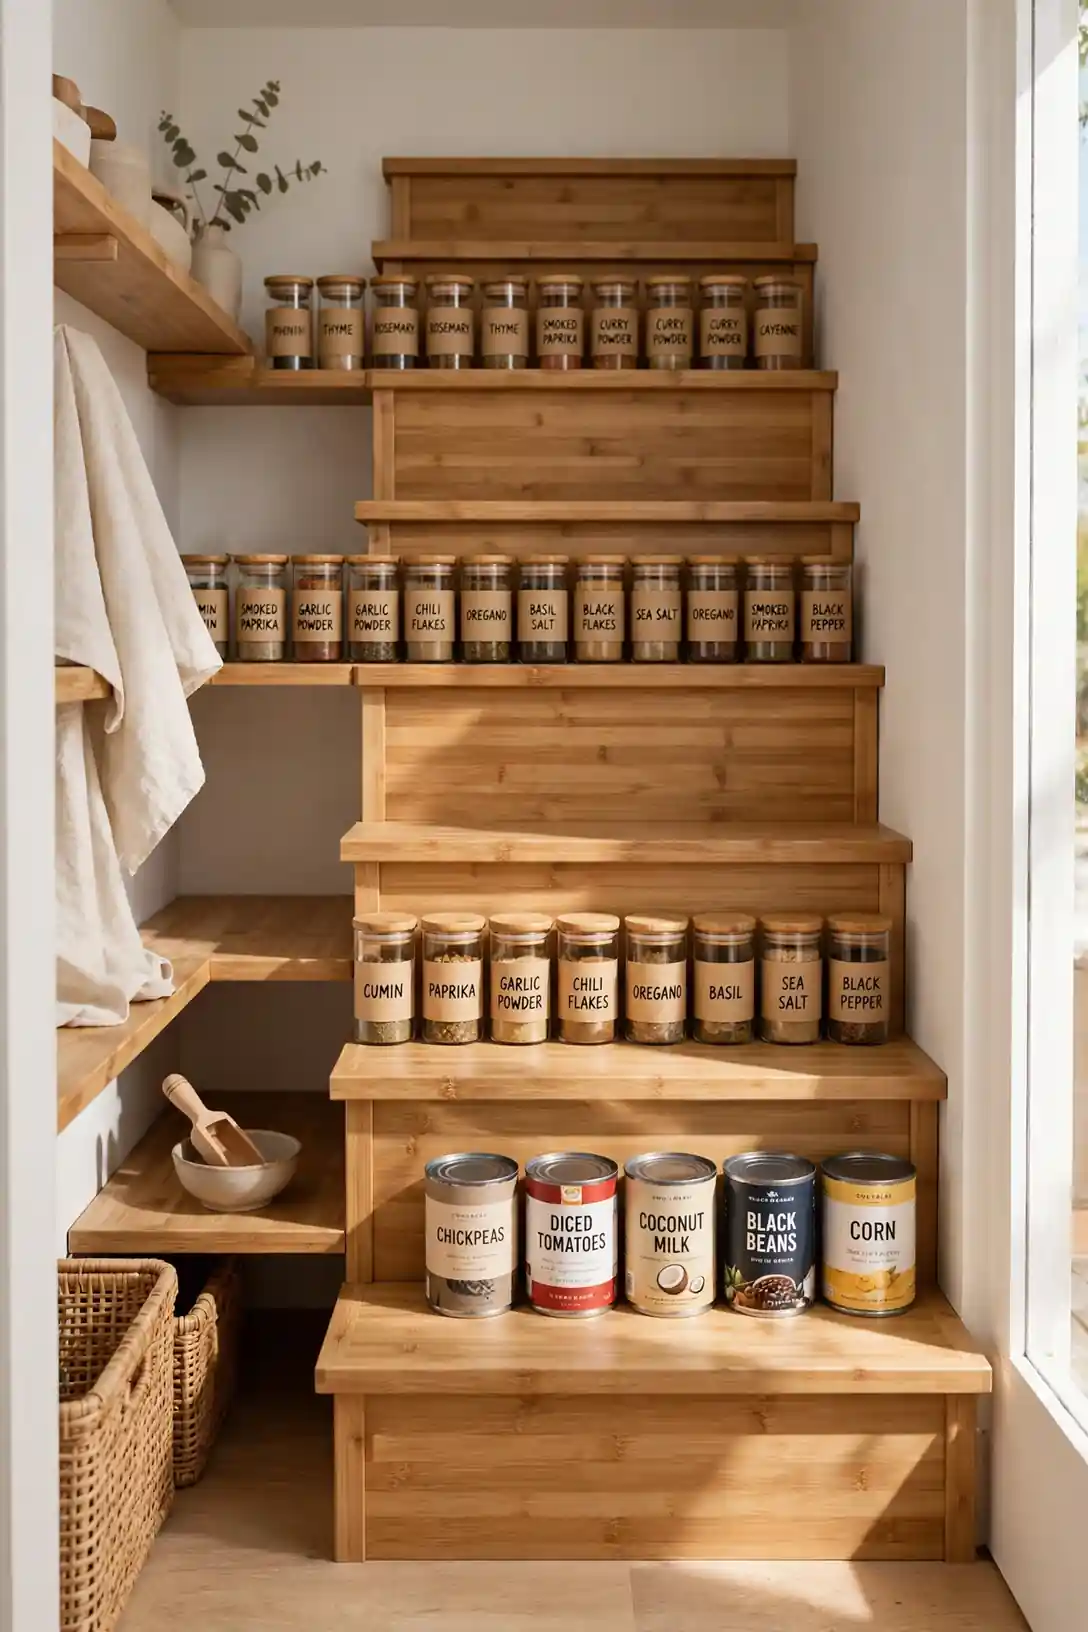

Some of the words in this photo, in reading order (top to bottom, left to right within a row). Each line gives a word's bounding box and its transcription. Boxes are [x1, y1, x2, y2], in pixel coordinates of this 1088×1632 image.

[323, 323, 353, 336] THYME
[490, 323, 519, 335] THYME
[543, 319, 577, 330] SMOKED
[600, 319, 629, 330] CURRY
[656, 318, 684, 331] CURRY
[710, 319, 739, 331] CURRY
[760, 324, 799, 336] CAYENNE
[543, 333, 577, 344] PAPRIKA
[598, 333, 632, 345] POWDER
[653, 334, 688, 345] POWDER
[707, 333, 742, 345] POWDER
[198, 604, 217, 614] MIN
[241, 603, 278, 615] SMOKED
[299, 603, 332, 616] GARLIC
[355, 603, 389, 616] GARLIC
[415, 603, 441, 615] CHILI
[466, 609, 507, 621] OREGANO
[529, 603, 557, 616] BASIL
[583, 603, 615, 616] BLACK
[635, 608, 653, 621] SEA
[655, 608, 679, 621] SALT
[692, 608, 735, 620] OREGANO
[751, 603, 789, 616] SMOKED
[812, 603, 844, 616] BLACK
[241, 618, 279, 631] PAPRIKA
[297, 619, 333, 631] POWDER
[354, 619, 391, 631] POWDER
[411, 618, 446, 630] FLAKES
[531, 619, 555, 630] SALT
[582, 619, 616, 631] FLAKES
[810, 619, 846, 631] PEPPER
[500, 976, 541, 991] GARLIC
[573, 976, 603, 992] CHILI
[782, 975, 805, 991] SEA
[842, 976, 881, 991] BLACK
[363, 983, 404, 999] CUMIN
[429, 982, 477, 999] PAPRIKA
[633, 984, 682, 1000] OREGANO
[709, 985, 743, 1000] BASIL
[497, 994, 543, 1010] POWDER
[568, 995, 609, 1010] FLAKES
[778, 994, 809, 1010] SALT
[840, 994, 883, 1010] PEPPER
[550, 1214, 593, 1233] DICED
[639, 1211, 705, 1233] COCONUT
[746, 1211, 797, 1232] BLACK
[436, 1226, 505, 1246] CHICKPEAS
[850, 1220, 896, 1242] CORN
[537, 1231, 606, 1254] TOMATOES
[654, 1235, 690, 1254] MILK
[746, 1232, 797, 1253] BEANS
